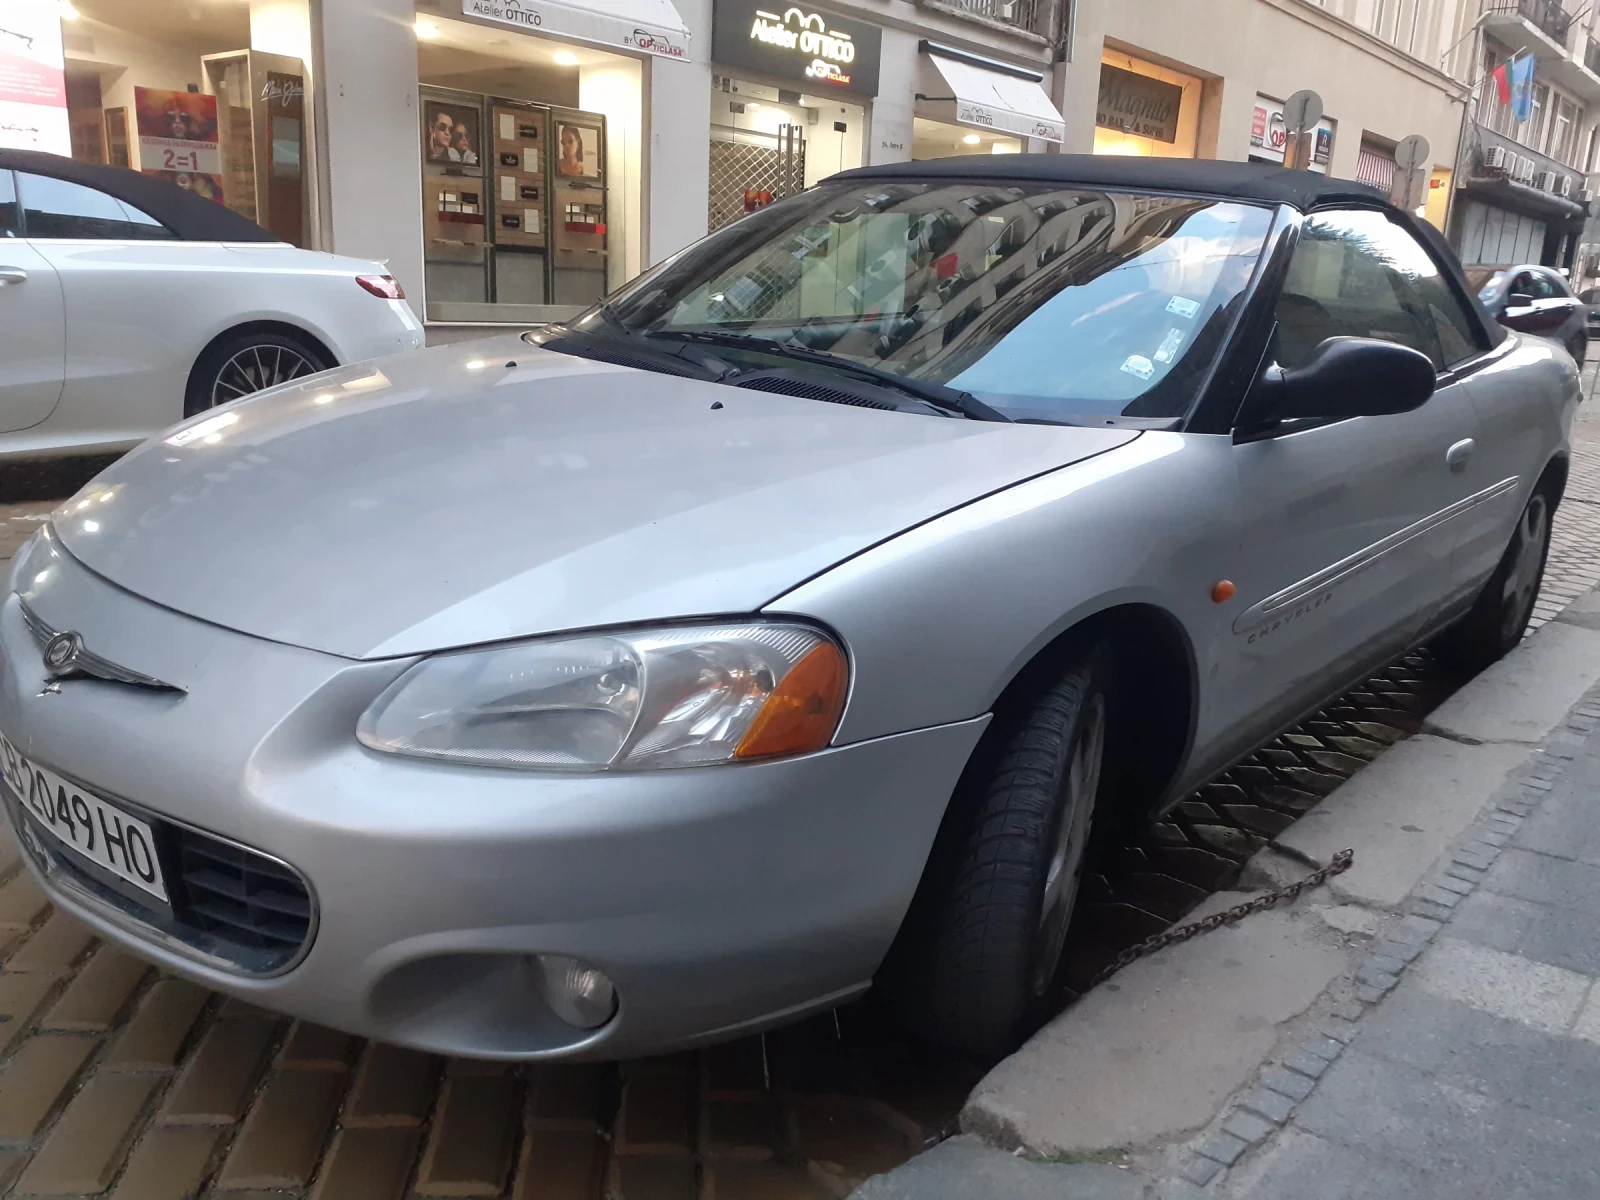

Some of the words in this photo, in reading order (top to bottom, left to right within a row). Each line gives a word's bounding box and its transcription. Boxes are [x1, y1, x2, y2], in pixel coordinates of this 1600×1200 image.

[473, 1, 503, 18] Atelier
[505, 8, 542, 26] OTTICO
[624, 36, 633, 44] BY
[639, 38, 682, 57] OPTICLASA
[800, 31, 855, 63] OTTICO
[163, 148, 198, 171] 2=1
[1247, 592, 1333, 645] CHRYSLER
[21, 756, 95, 851] 2049
[97, 806, 155, 884] HO
